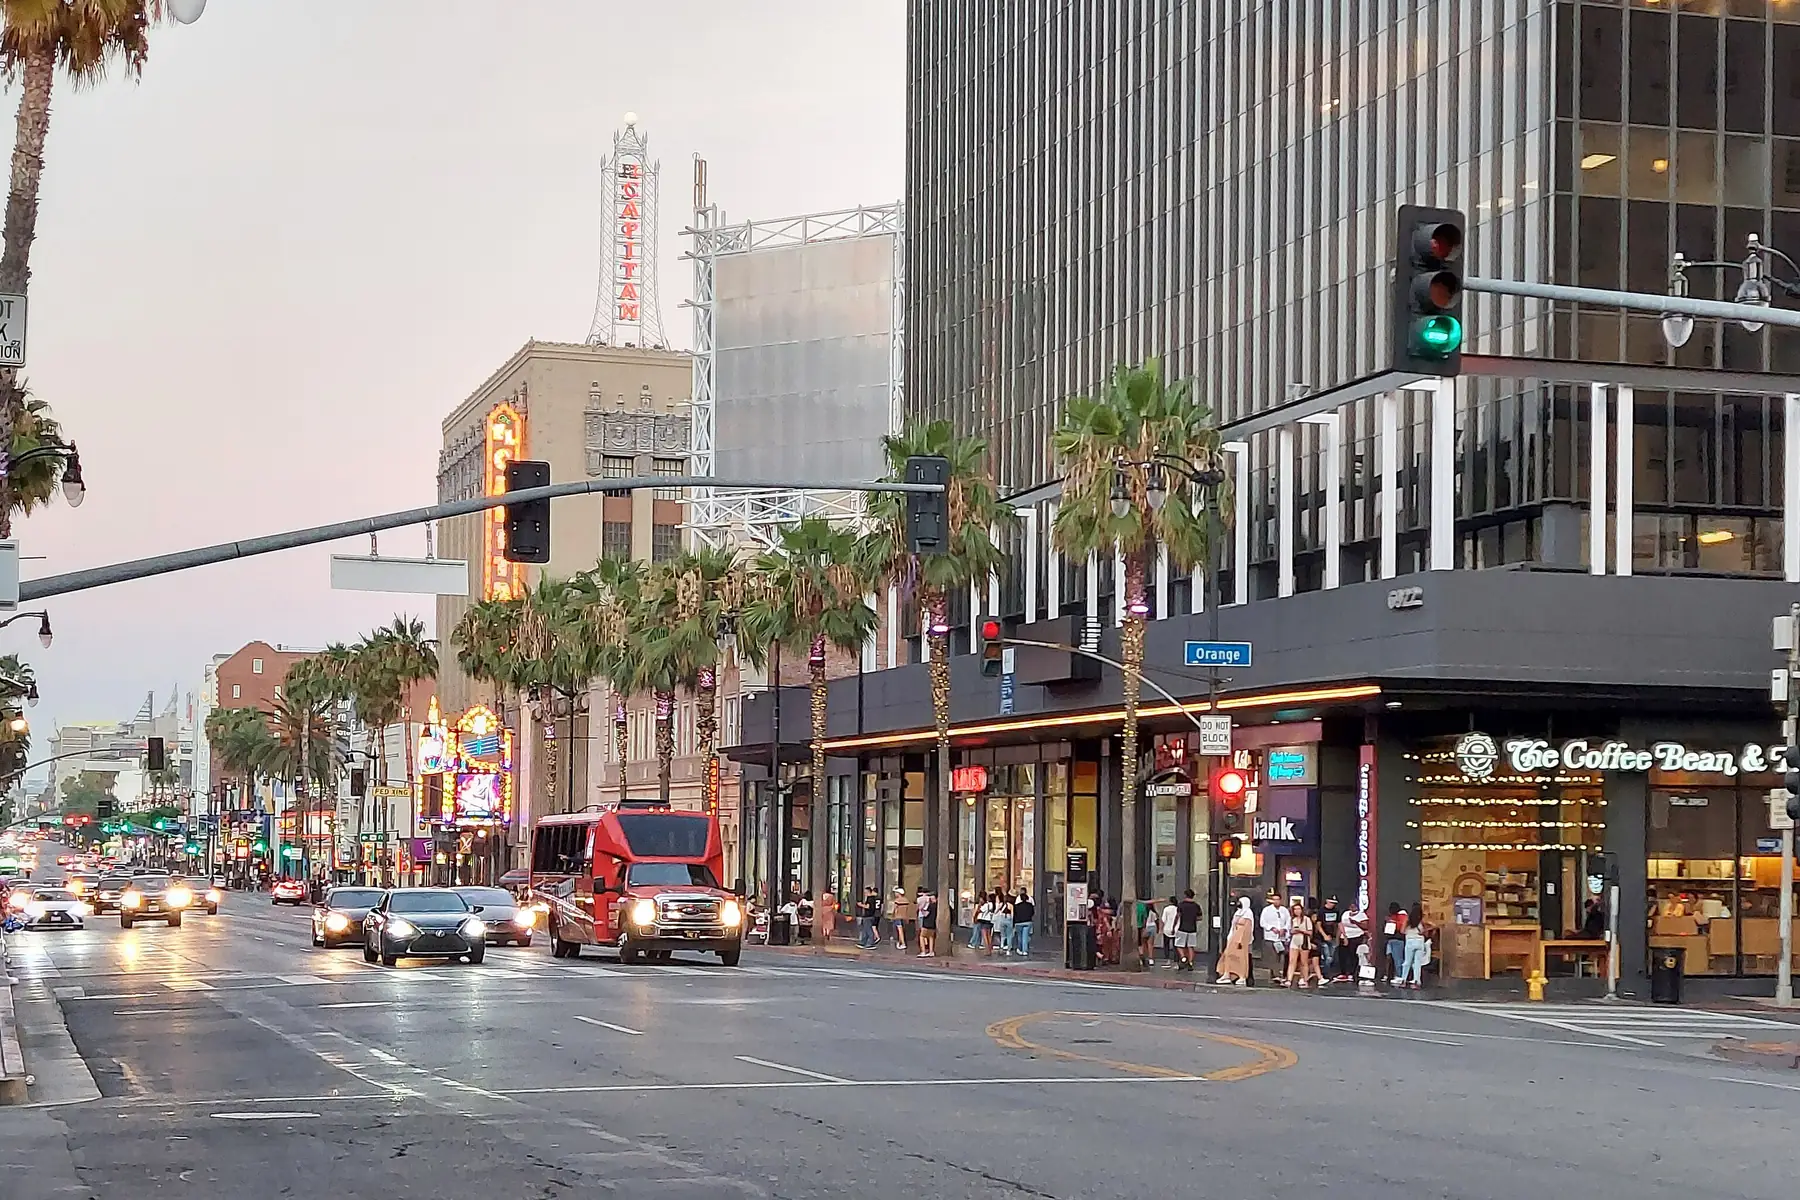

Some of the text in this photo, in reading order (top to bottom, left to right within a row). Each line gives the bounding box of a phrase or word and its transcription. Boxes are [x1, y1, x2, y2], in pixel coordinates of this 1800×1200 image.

[1195, 647, 1240, 664] Orange
[1201, 721, 1229, 730] DO NOT
[1202, 733, 1229, 742] BLOCK
[1506, 740, 1560, 772] The
[1563, 740, 1653, 770] Coffee
[1654, 744, 1738, 776] Bean
[1741, 744, 1768, 772] &
[374, 787, 390, 795] PED
[1253, 816, 1296, 840] bank
